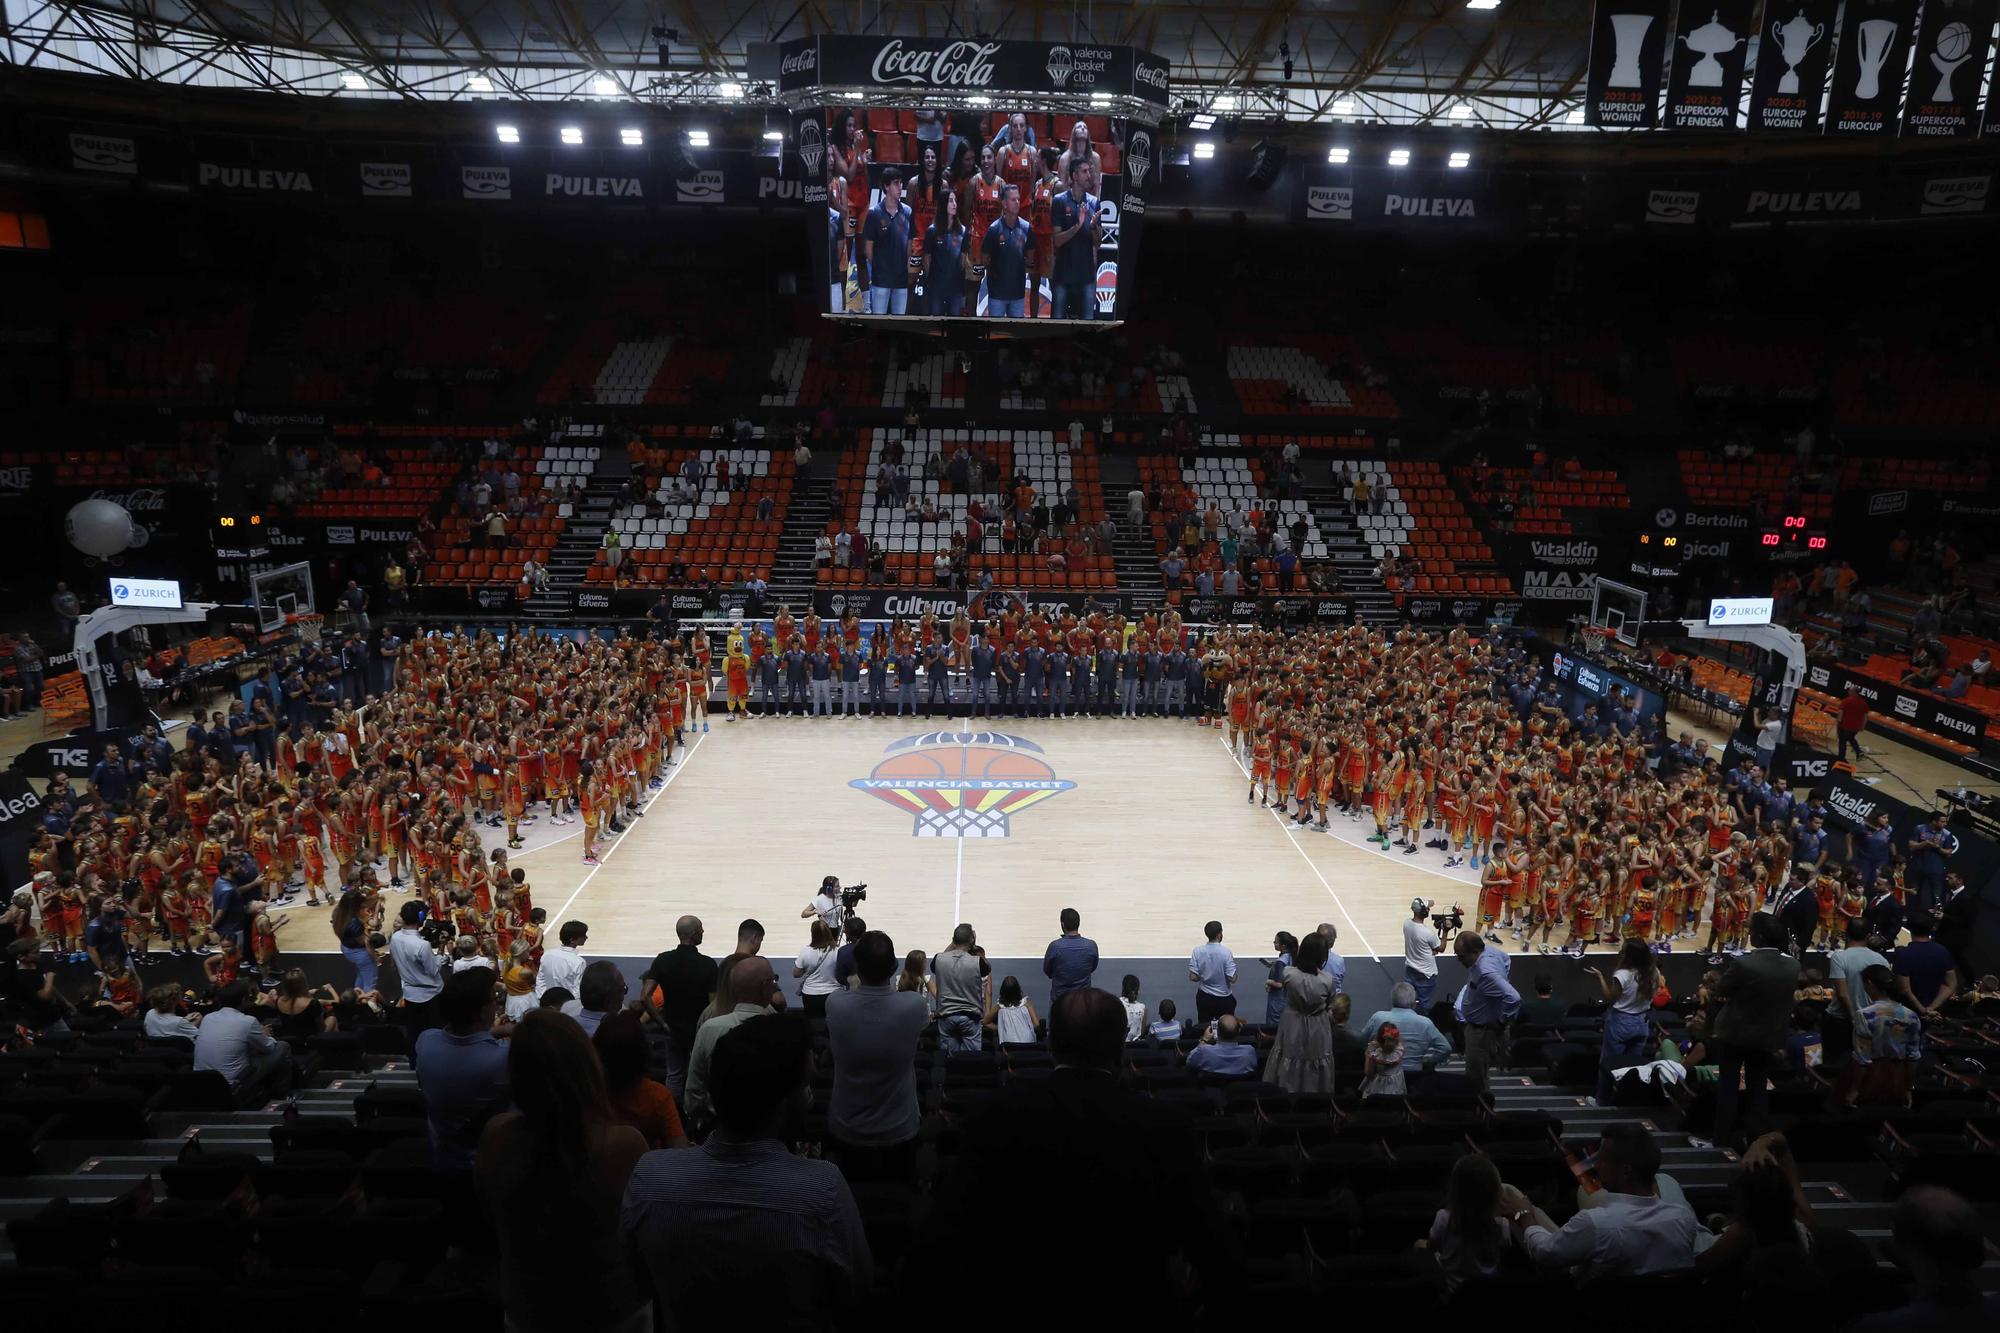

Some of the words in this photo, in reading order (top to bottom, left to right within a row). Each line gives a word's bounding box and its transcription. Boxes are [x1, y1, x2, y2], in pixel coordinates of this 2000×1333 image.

[1074, 47, 1112, 60] valencia
[780, 47, 817, 75] Coca-Cola
[871, 39, 1001, 87] Coca-Cola
[1074, 60, 1105, 71] basket
[1073, 72, 1095, 82] club
[1135, 62, 1168, 89] Coca-Cola
[1598, 102, 1646, 113] SUPERCUP
[1674, 105, 1729, 116] SUPERCOPA
[1762, 108, 1807, 119] EUROCUP
[1601, 112, 1641, 122] WOMEN
[1676, 116, 1688, 126] LF
[1689, 117, 1724, 127] ENDESA
[1763, 118, 1803, 128] WOMEN
[1909, 115, 1966, 126] SUPERCOPA
[1837, 120, 1883, 131] EUROCUP
[1917, 125, 1955, 136] ENDESA
[74, 137, 132, 153] PULEVA
[200, 163, 312, 191] PULEVA
[363, 166, 408, 180] PULEVA
[464, 169, 508, 182] PULEVA
[545, 174, 643, 197] PULEVA
[1928, 182, 1985, 194] PULEVA
[804, 193, 828, 202] Esfuerzo
[1311, 190, 1350, 200] PULEVA
[1652, 193, 1696, 206] PULEVA
[1122, 202, 1145, 214] Esfuerzo
[1384, 194, 1475, 217] PULEVA
[1746, 191, 1863, 213] PULEVA
[221, 518, 235, 527] 00
[360, 529, 415, 542] PULEVA
[1640, 534, 1649, 544] 00
[1664, 537, 1677, 546] 00
[1762, 534, 1780, 546] 00
[1531, 540, 1599, 557] Vitaldin
[1808, 537, 1827, 549] 00
[1564, 557, 1597, 566] SPORT
[1523, 570, 1599, 588] MAX
[134, 588, 175, 598] ZURICH
[579, 593, 602, 601] Cultura
[578, 599, 609, 608] Esfuerzo
[672, 601, 702, 609] Esfuerzo
[1730, 607, 1768, 616] ZURICH
[49, 651, 78, 667] PULE
[1578, 675, 1600, 692] Esfuerzo
[1936, 712, 1976, 736] PULEVA
[48, 748, 89, 767] TKE
[1792, 760, 1828, 776] TKE
[863, 780, 972, 788] VALENCIA
[980, 780, 1063, 788] BASKET
